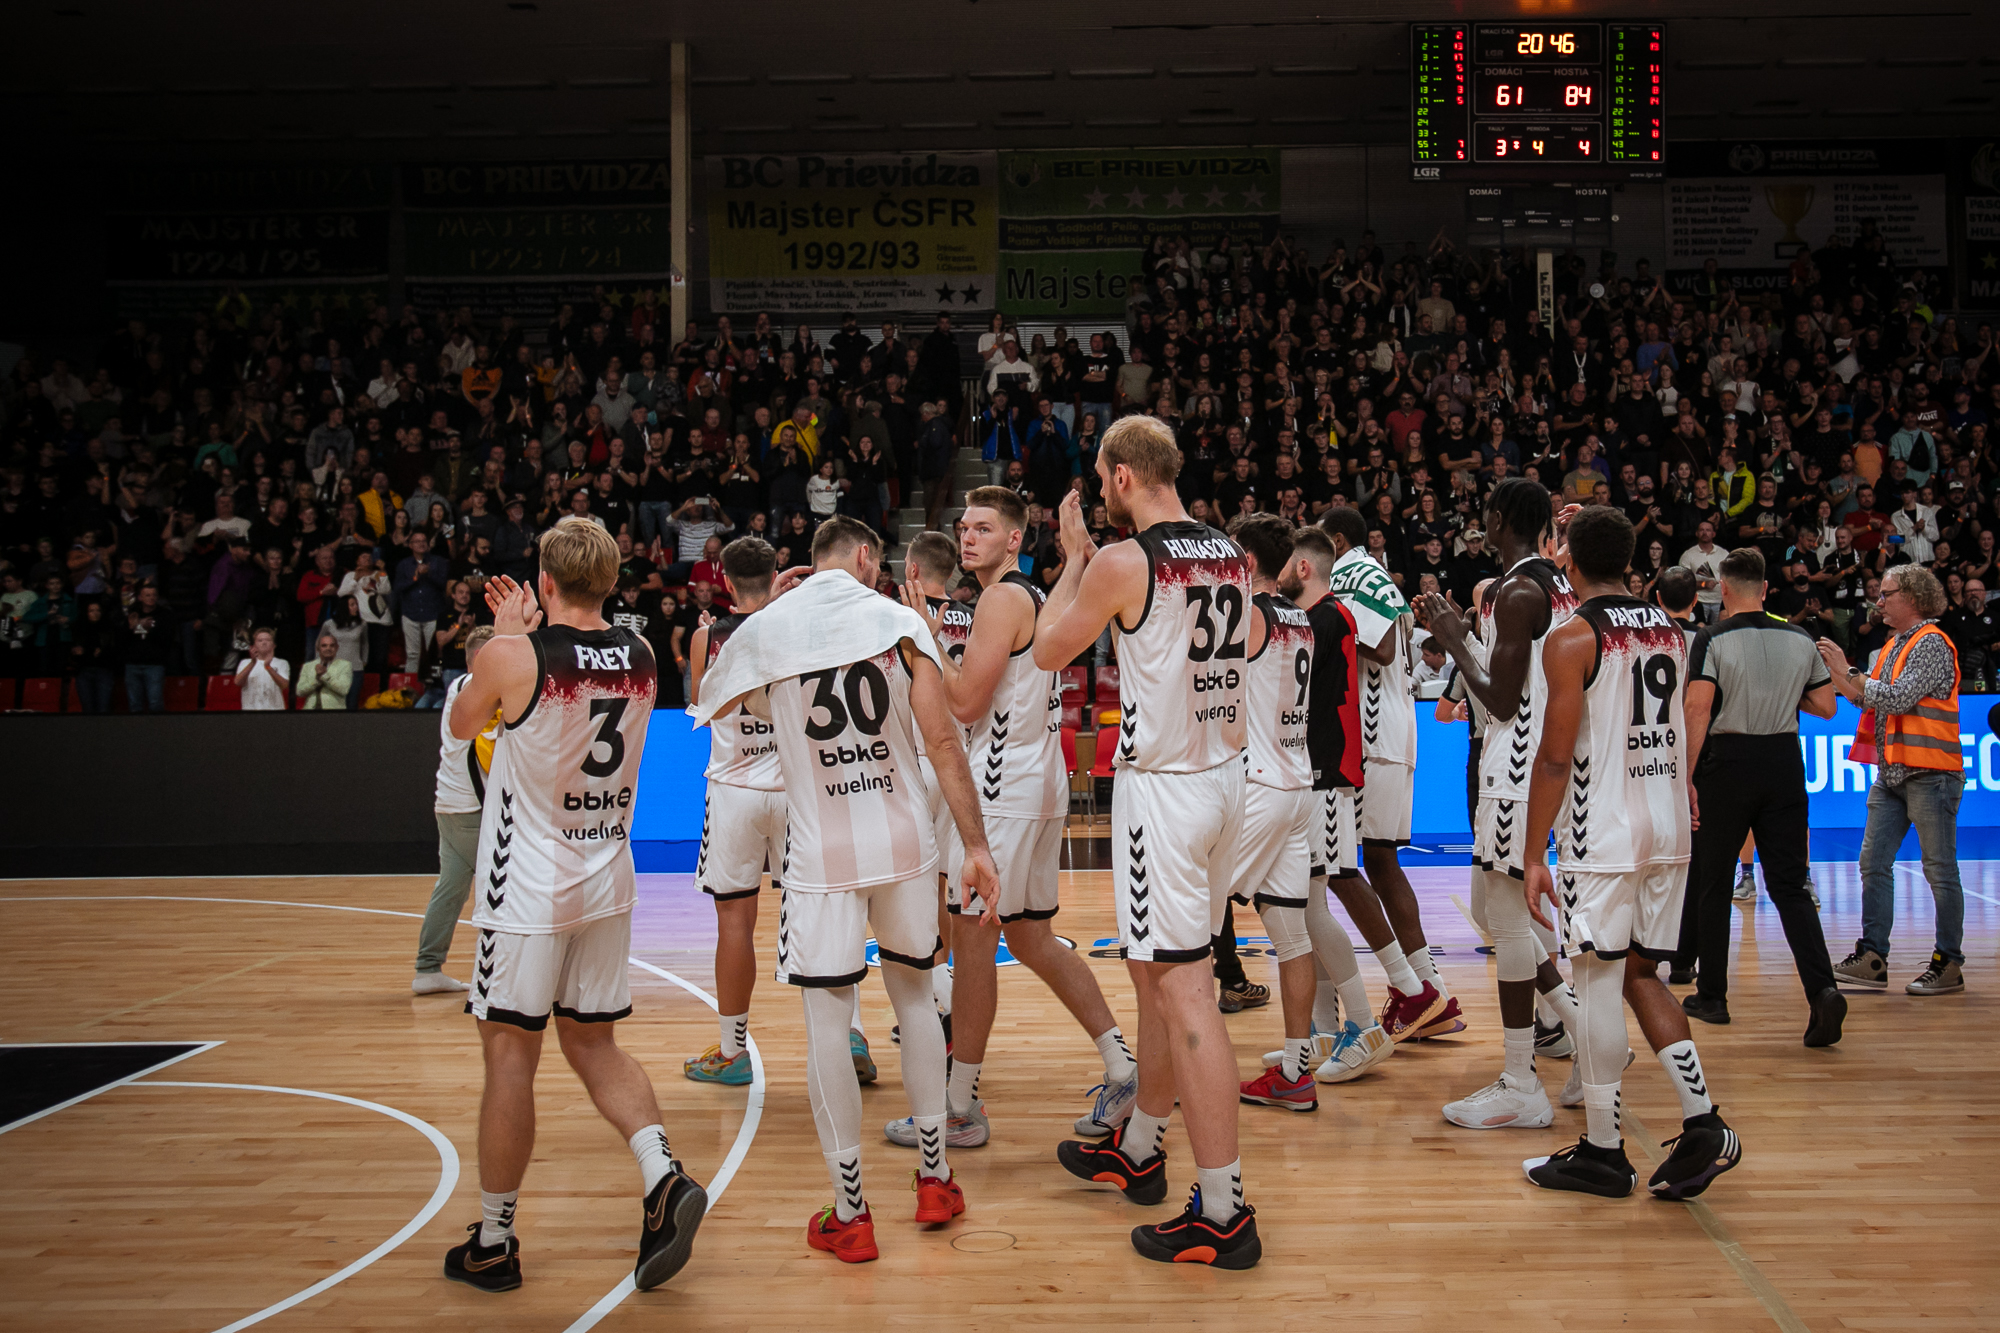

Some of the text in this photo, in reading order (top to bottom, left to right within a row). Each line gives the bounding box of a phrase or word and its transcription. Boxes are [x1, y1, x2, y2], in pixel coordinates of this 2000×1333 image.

[1424, 32, 1428, 40] 1
[1518, 34, 1574, 54] 20 46
[1485, 67, 1522, 76] DOMÁCI
[1554, 68, 1589, 76] HOSTIA
[1650, 64, 1660, 72] 11
[1420, 86, 1428, 94] 13
[1496, 84, 1524, 106] 61
[1564, 84, 1592, 106] 84
[1616, 86, 1624, 94] 17
[1417, 118, 1428, 126] 24
[1417, 140, 1428, 148] 55
[1496, 139, 1507, 157] 3
[1532, 140, 1544, 156] 4
[1578, 140, 1590, 156] 4
[1612, 140, 1624, 148] 43
[1456, 150, 1464, 160] 5
[1770, 150, 1878, 161] PRIEVIDZA
[722, 154, 981, 189] BC Prievidza
[1052, 157, 1273, 179] BC PRIEVIDZA
[1414, 168, 1440, 177] LGR
[422, 167, 472, 194] BC
[1469, 188, 1502, 196] DOMÁCI
[727, 192, 977, 236] Majster ČSFR
[141, 215, 359, 241] MAJSTER SR
[438, 214, 597, 237] MAJSTER
[783, 240, 921, 271] 1992/93
[1917, 410, 1938, 421] VANS
[1163, 538, 1238, 559] HLINASON
[1186, 584, 1245, 662] 32
[1604, 606, 1671, 630] PANTZAR
[574, 644, 632, 670] FREY
[1295, 648, 1310, 706] 9
[800, 660, 890, 740] 30
[1631, 653, 1677, 726] 19
[580, 698, 630, 778] 3
[1628, 756, 1677, 782] vueling
[825, 768, 894, 797] vueling
[562, 817, 627, 841] vueling
